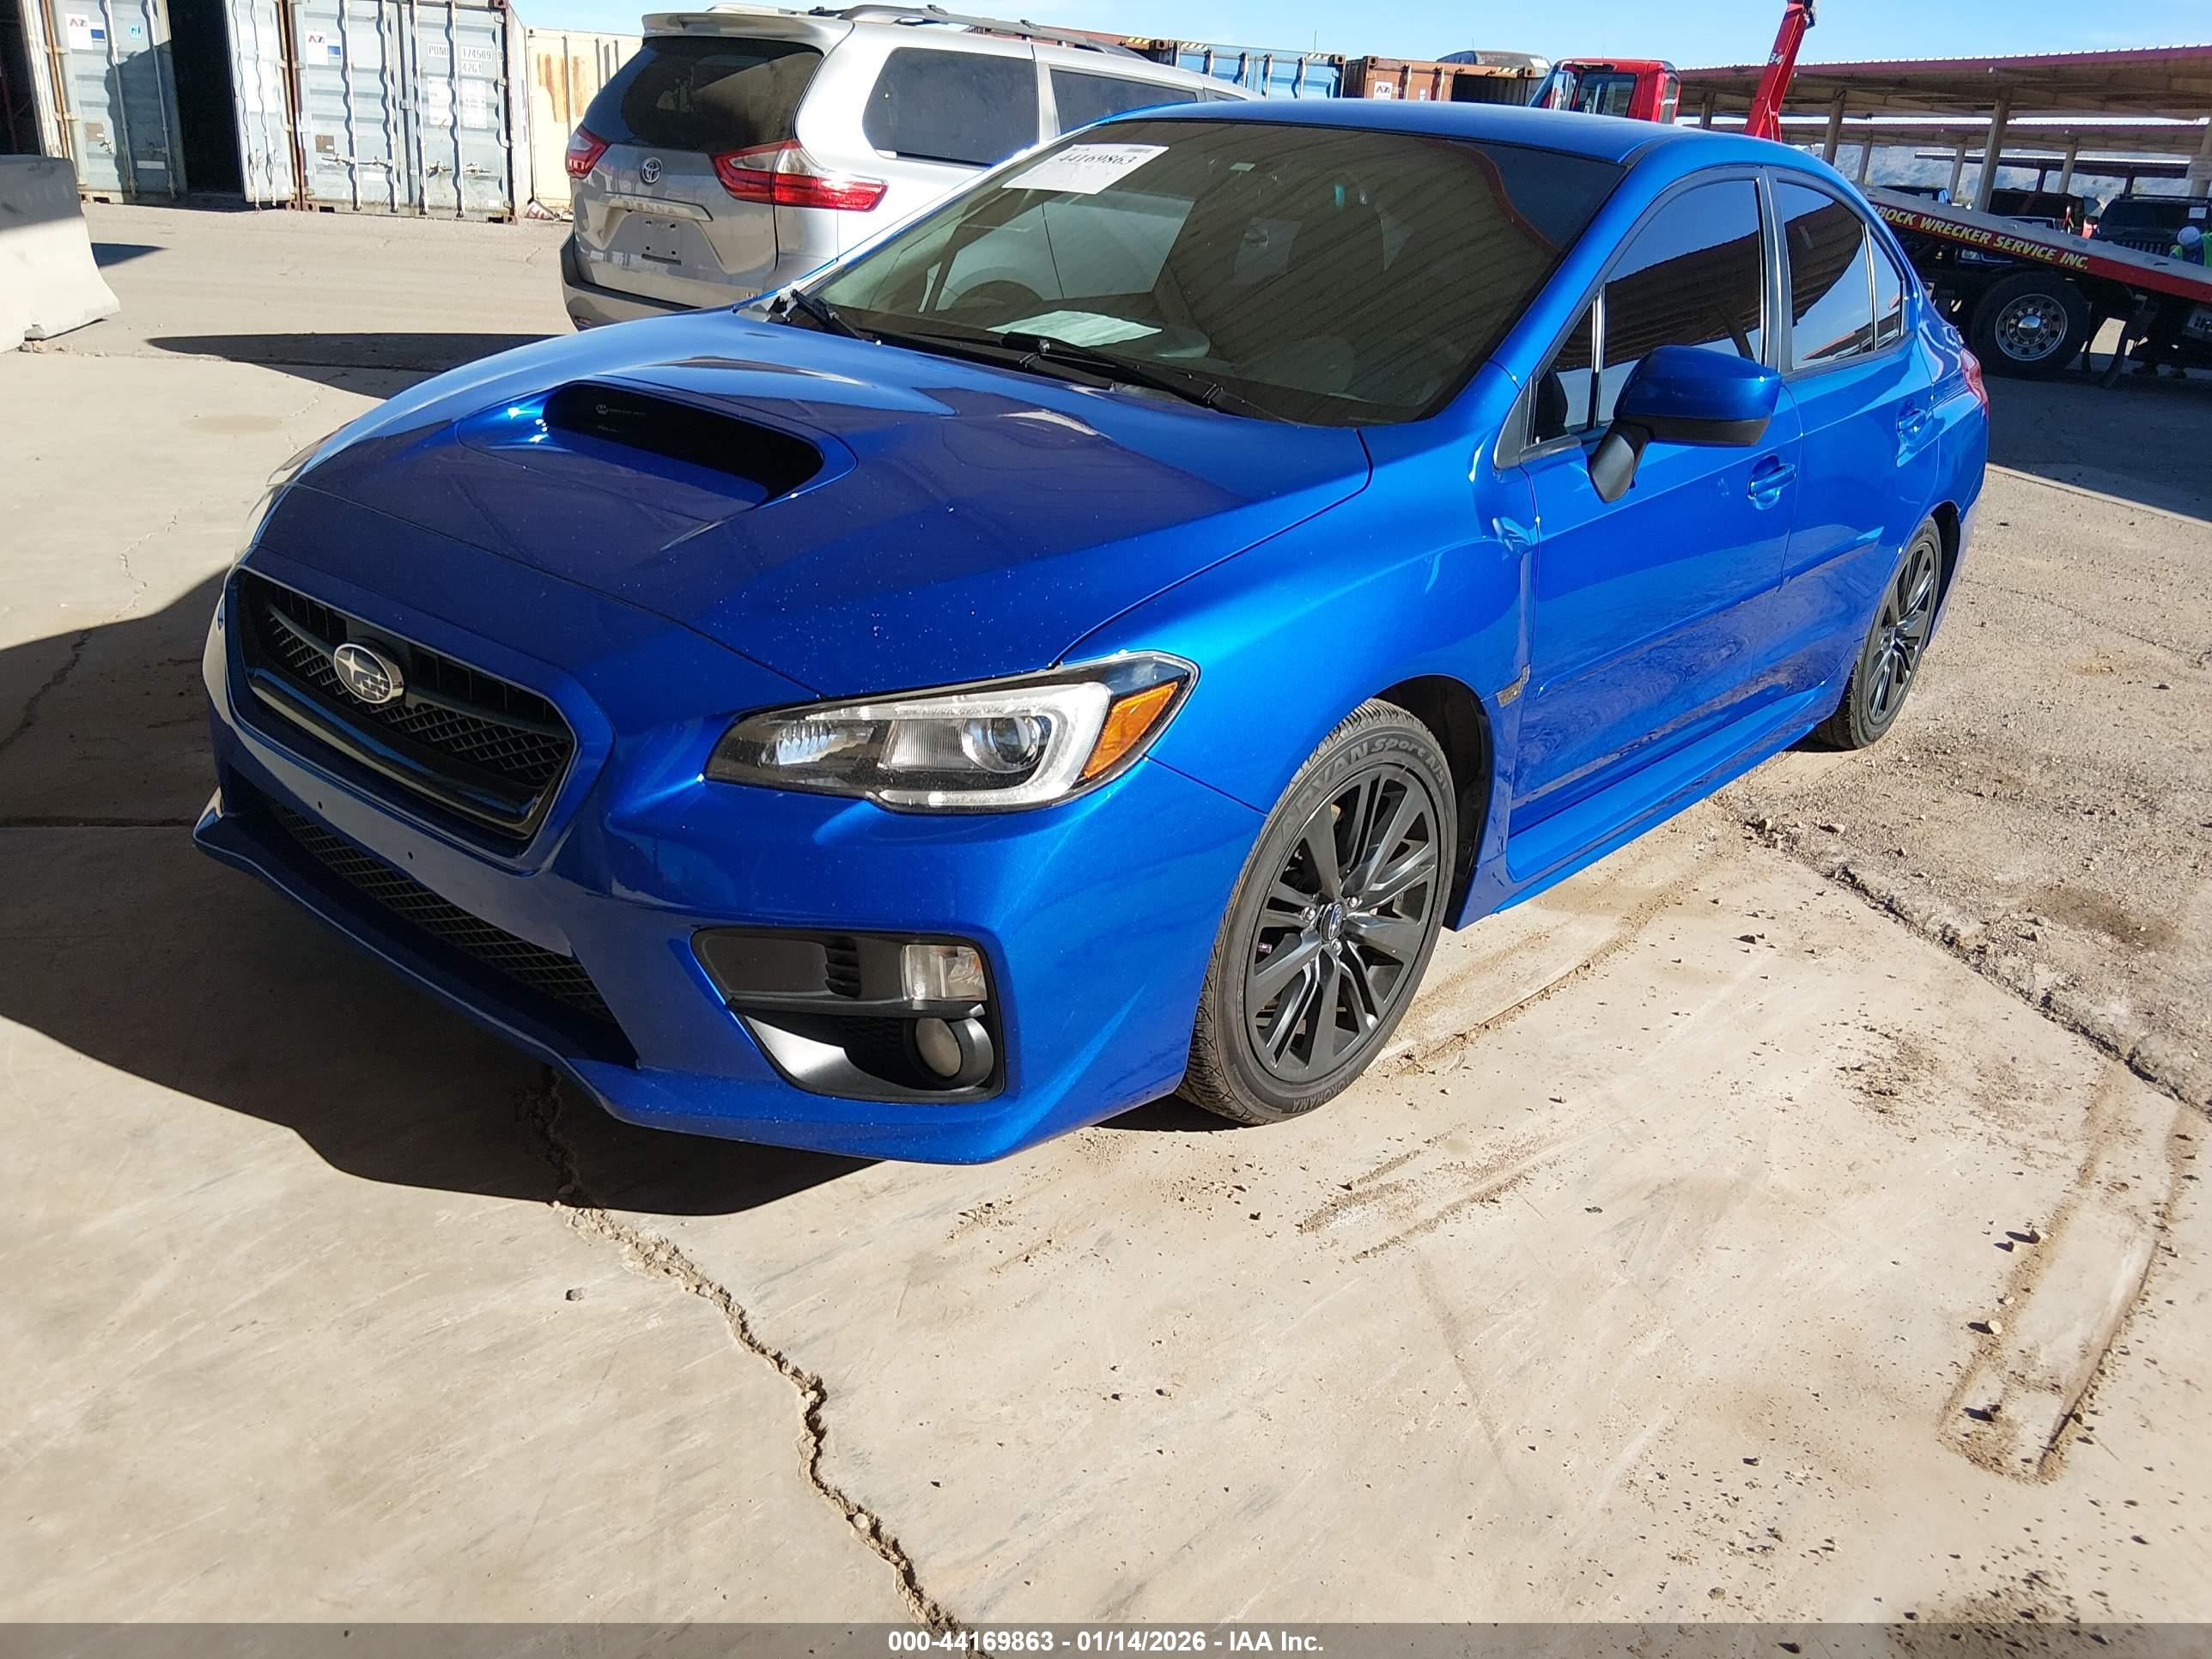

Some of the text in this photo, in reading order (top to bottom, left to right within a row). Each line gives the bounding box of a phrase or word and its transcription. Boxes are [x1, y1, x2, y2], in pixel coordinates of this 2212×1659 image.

[1769, 52, 1784, 65] 34
[1059, 153, 1138, 166] 44169863
[1919, 216, 1996, 245] WRECKER
[1992, 235, 2061, 261] SERVICE
[2059, 251, 2088, 270] INC.
[1291, 1076, 1350, 1113] YOKOHAMA
